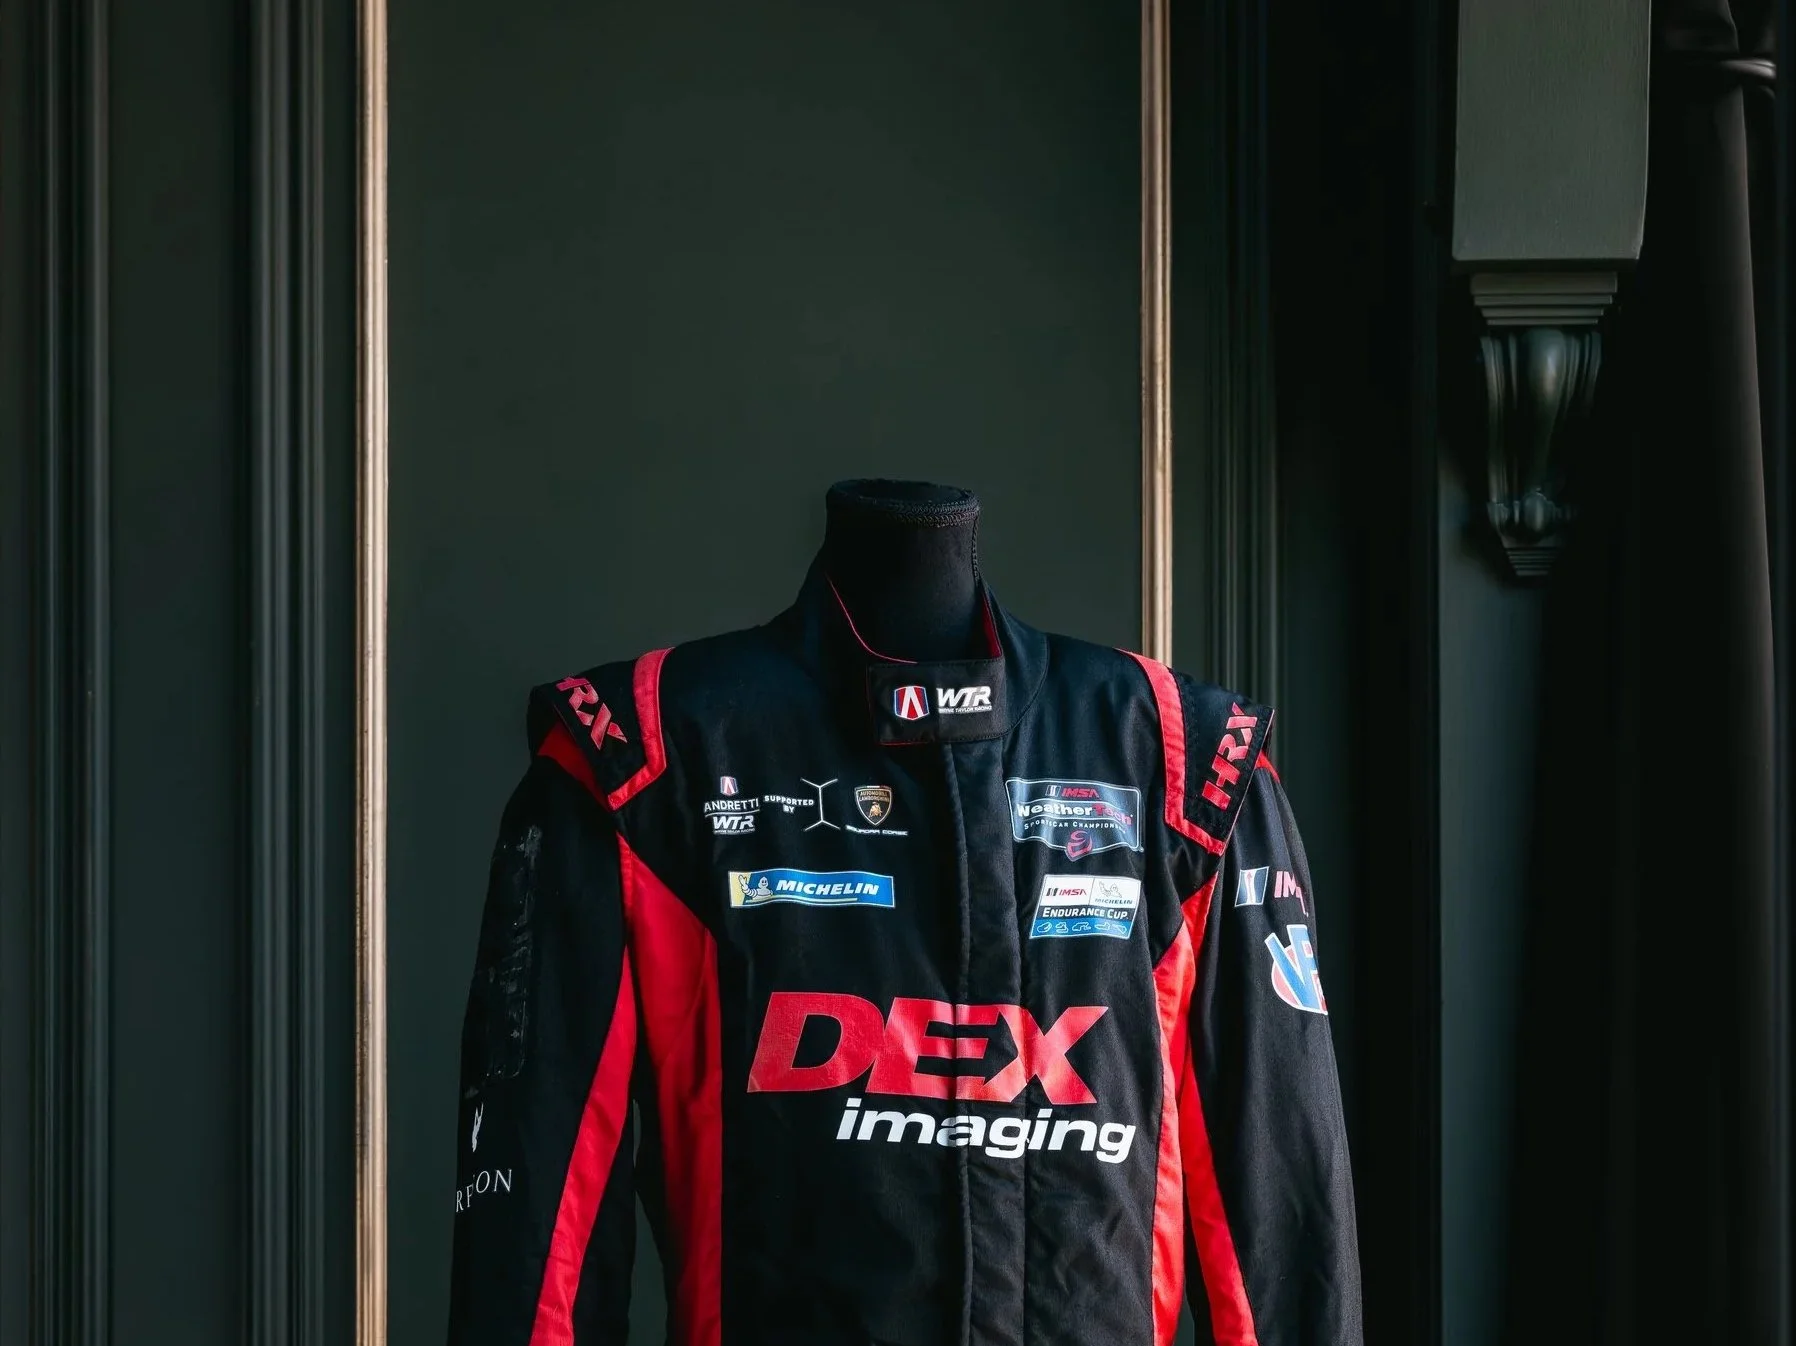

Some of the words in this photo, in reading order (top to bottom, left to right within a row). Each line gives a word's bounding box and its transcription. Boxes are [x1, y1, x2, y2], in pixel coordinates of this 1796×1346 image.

[936, 686, 992, 707] WTR
[1202, 702, 1258, 810] HRX
[1062, 787, 1100, 798] IMSA
[704, 798, 760, 812] ANDRETTI
[764, 795, 815, 806] SUPPORTED
[783, 804, 795, 813] BY
[713, 815, 755, 830] WTR
[776, 880, 880, 896] MICHELIN
[1059, 888, 1087, 896] IMSA
[1042, 907, 1105, 918] ENDURANCE
[1107, 909, 1129, 920] CUP
[747, 992, 1109, 1106] DEX
[836, 1098, 1137, 1164] imaging
